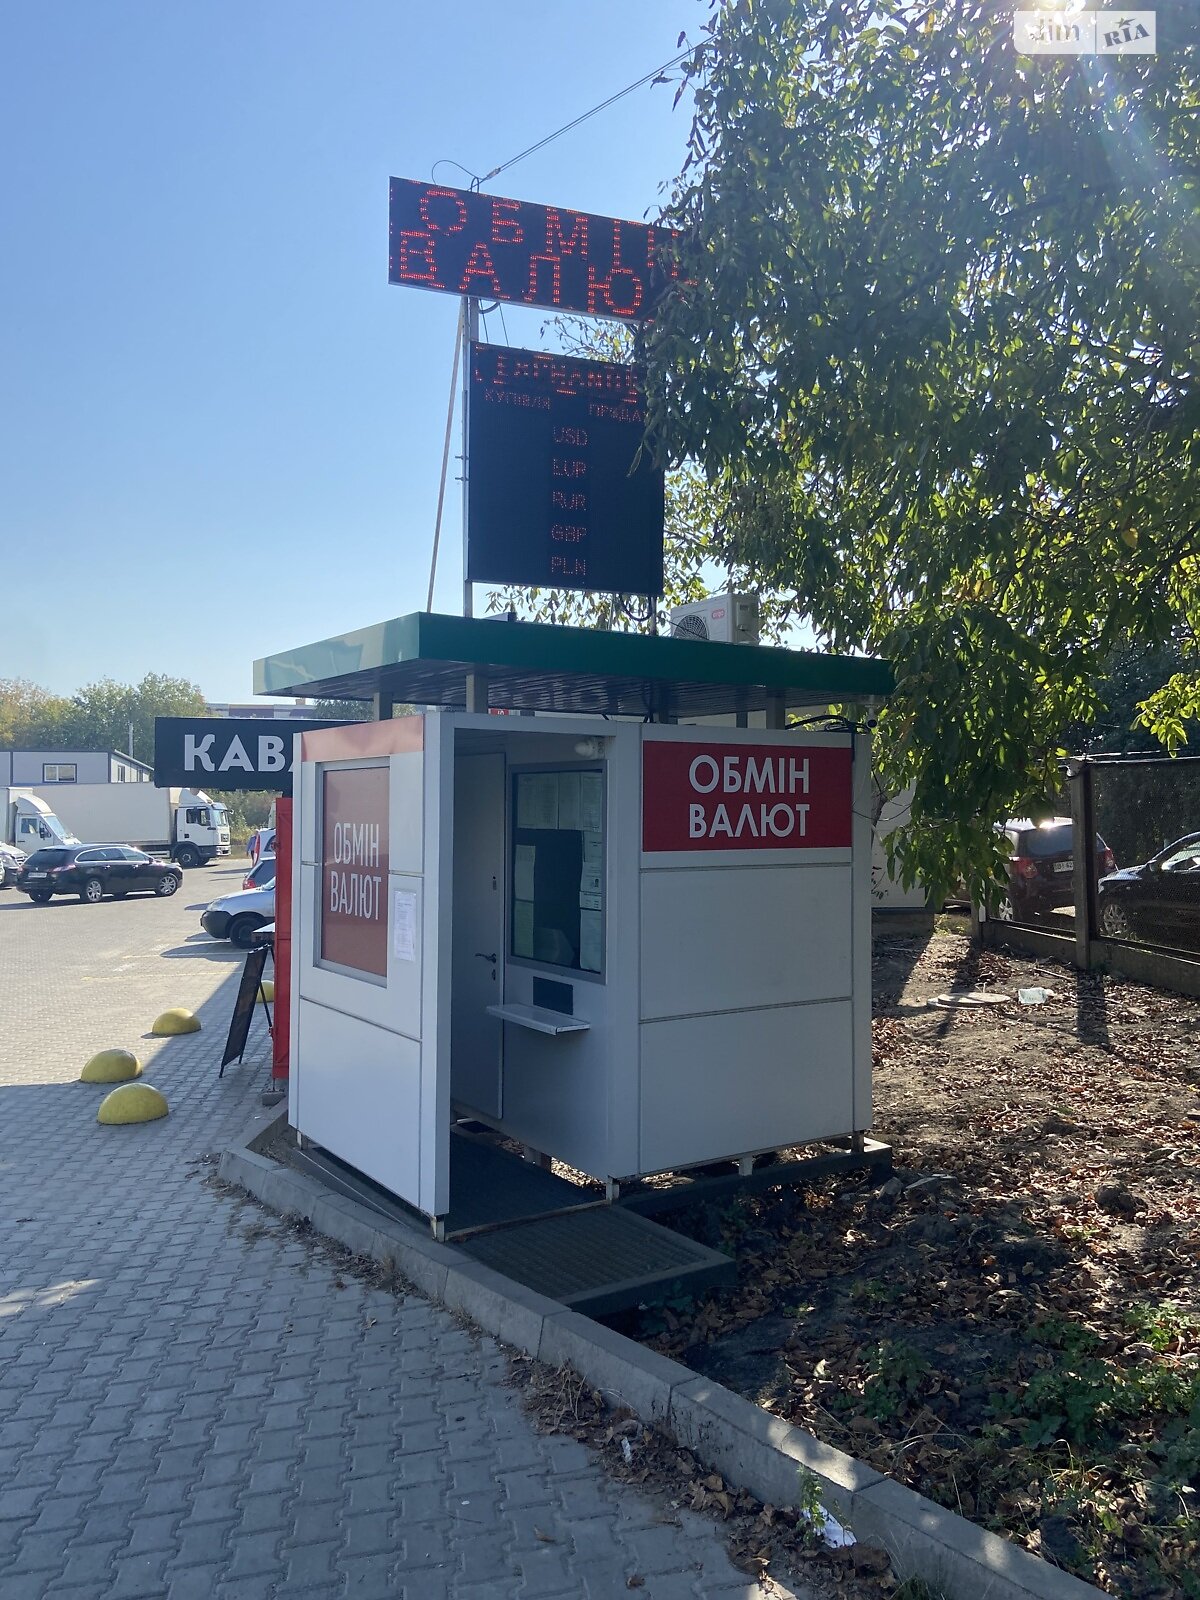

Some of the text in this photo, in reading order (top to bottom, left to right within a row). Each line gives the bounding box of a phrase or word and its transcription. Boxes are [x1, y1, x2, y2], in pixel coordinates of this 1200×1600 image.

[400, 229, 698, 314] ВАЛЮ
[553, 426, 588, 446] USD
[551, 524, 587, 543] GBP
[551, 556, 586, 575] PLN
[184, 733, 294, 773] КАВ
[688, 754, 810, 794] ОБМІН
[688, 803, 810, 838] ВАЛЮТ
[334, 822, 379, 868] ОБМІН
[330, 870, 382, 920] ВАЛЮТ
